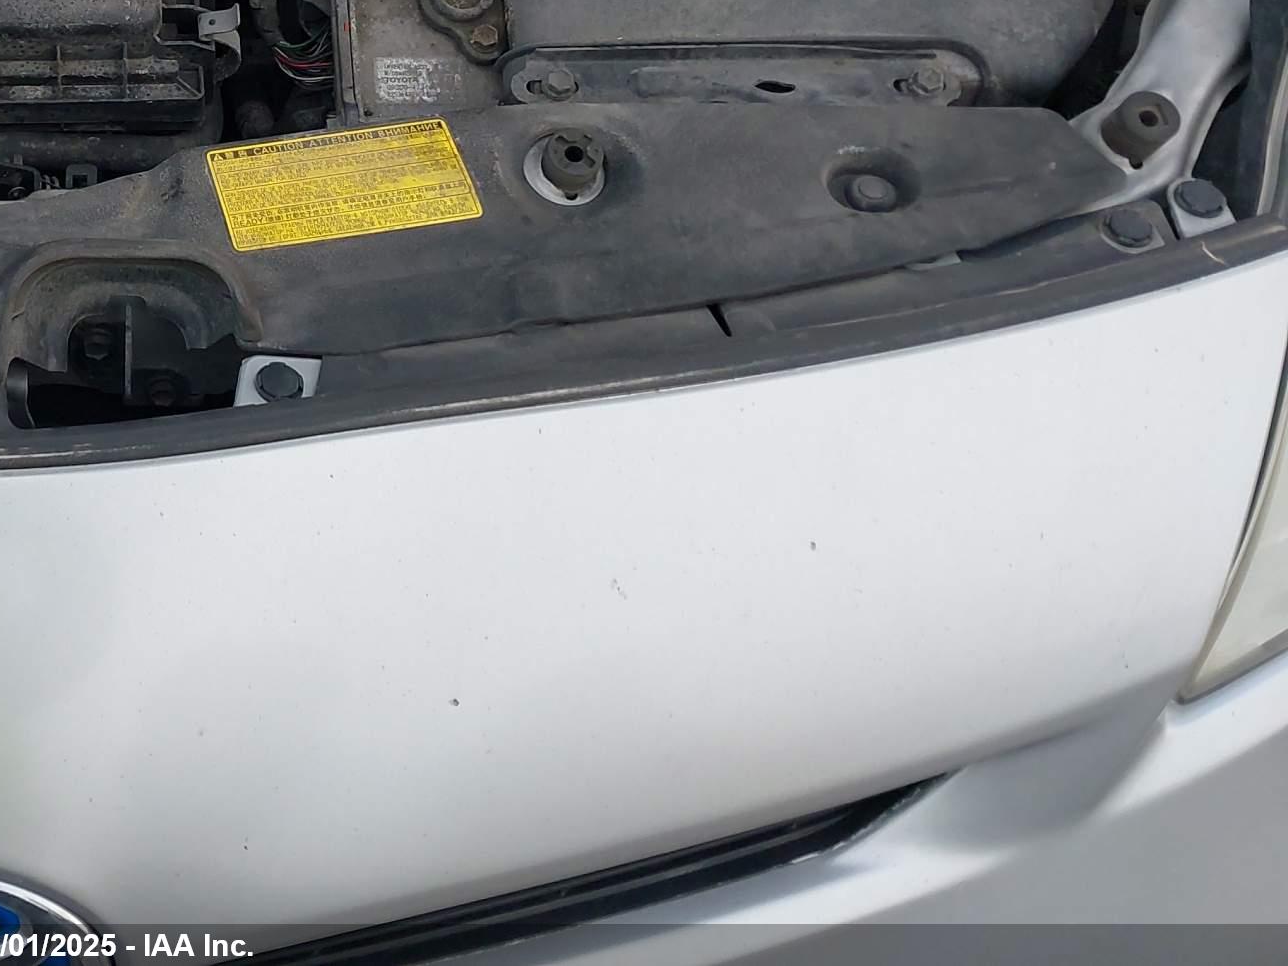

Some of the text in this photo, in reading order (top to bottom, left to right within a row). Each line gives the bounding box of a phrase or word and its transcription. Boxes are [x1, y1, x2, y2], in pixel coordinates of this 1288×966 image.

[253, 142, 304, 156] CAUTION
[309, 132, 373, 148] ATTENTION
[378, 123, 441, 139] ВНИМАНИЕ
